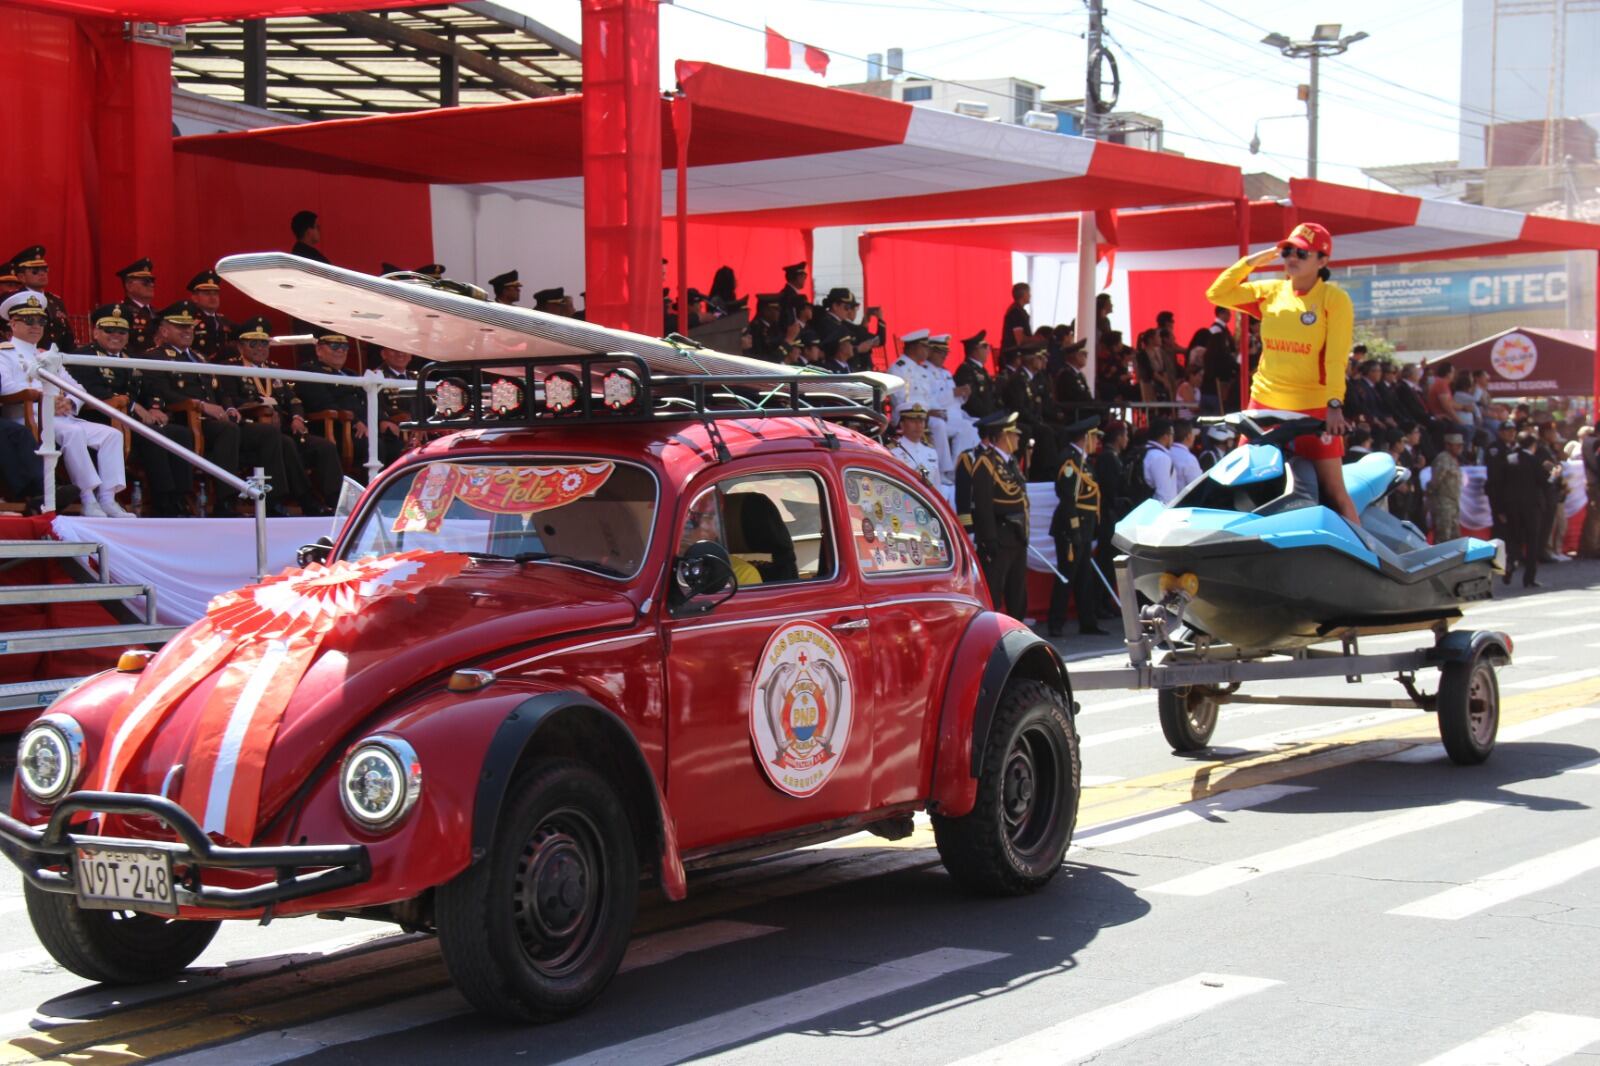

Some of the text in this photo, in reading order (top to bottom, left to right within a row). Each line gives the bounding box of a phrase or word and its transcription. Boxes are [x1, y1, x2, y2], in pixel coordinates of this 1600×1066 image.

[1371, 277, 1451, 288] INSTITUTO DE
[1469, 271, 1568, 306] CITEC
[495, 468, 553, 508] Feliz
[793, 706, 817, 728] PNP
[1051, 707, 1080, 789] TOURADOR
[81, 861, 169, 901] V9T-248
